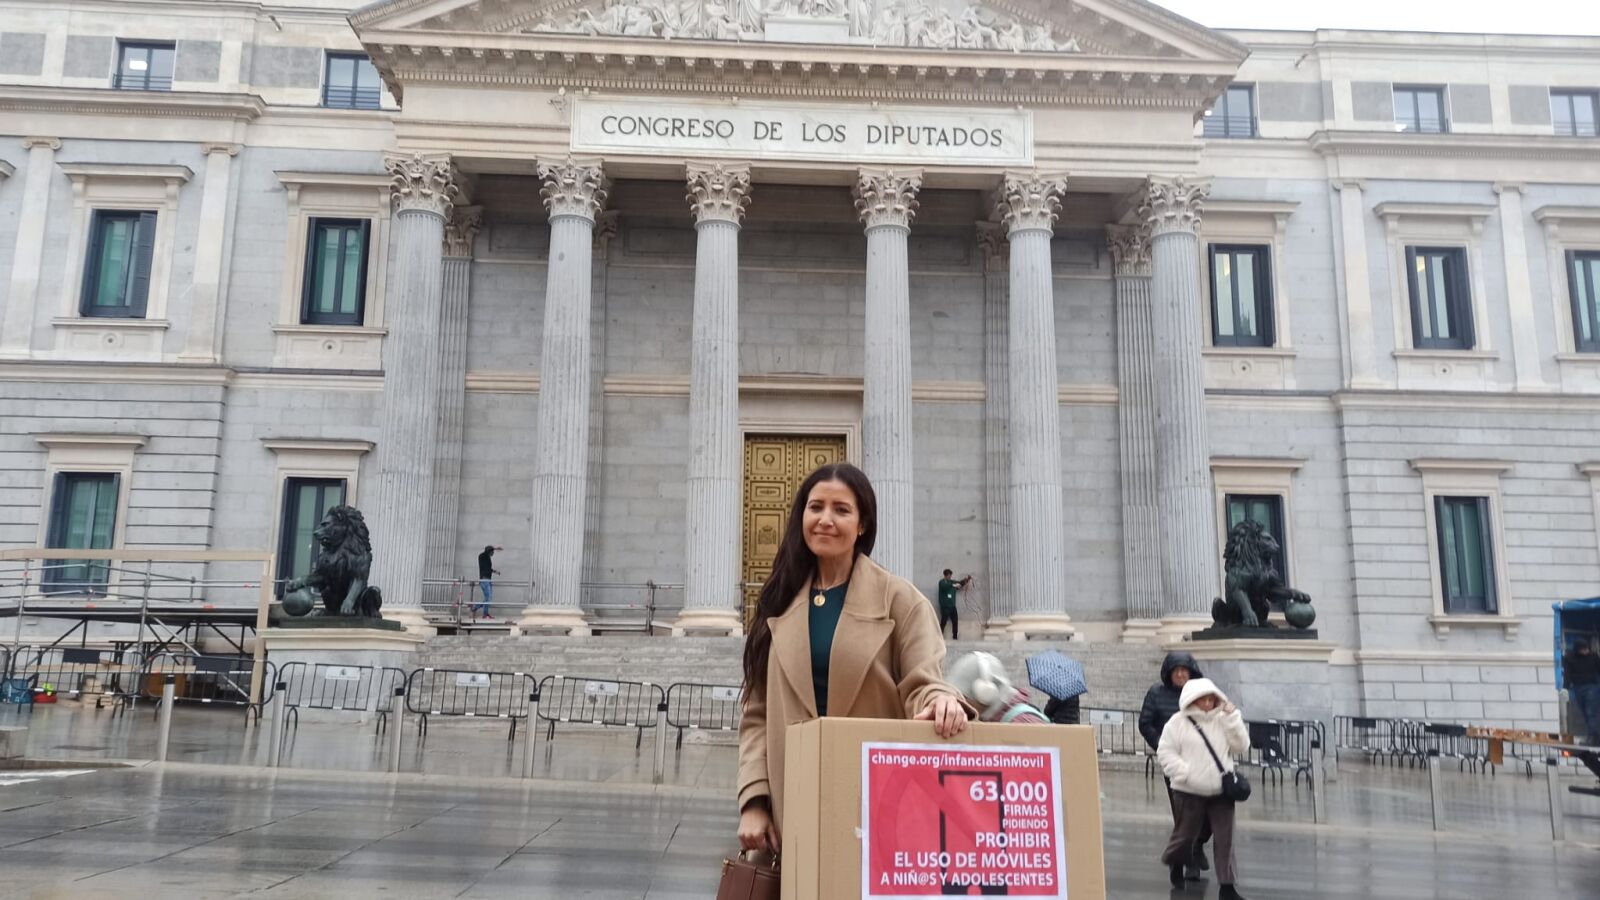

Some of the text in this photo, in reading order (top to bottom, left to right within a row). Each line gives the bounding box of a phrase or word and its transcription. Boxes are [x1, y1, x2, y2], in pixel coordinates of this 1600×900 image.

[601, 115, 1003, 147] CONGRESO DE LOS DIPUTADOS
[969, 780, 1048, 802] 63.000
[1003, 804, 1048, 817] FIRMAS
[1002, 818, 1049, 830] PIDIENDO
[975, 832, 1051, 848] PROHIBIR
[894, 849, 1052, 869] EL USO DE MÓVILES
[880, 869, 1054, 887] A NIÑ@S Y ADOLESCENTES
